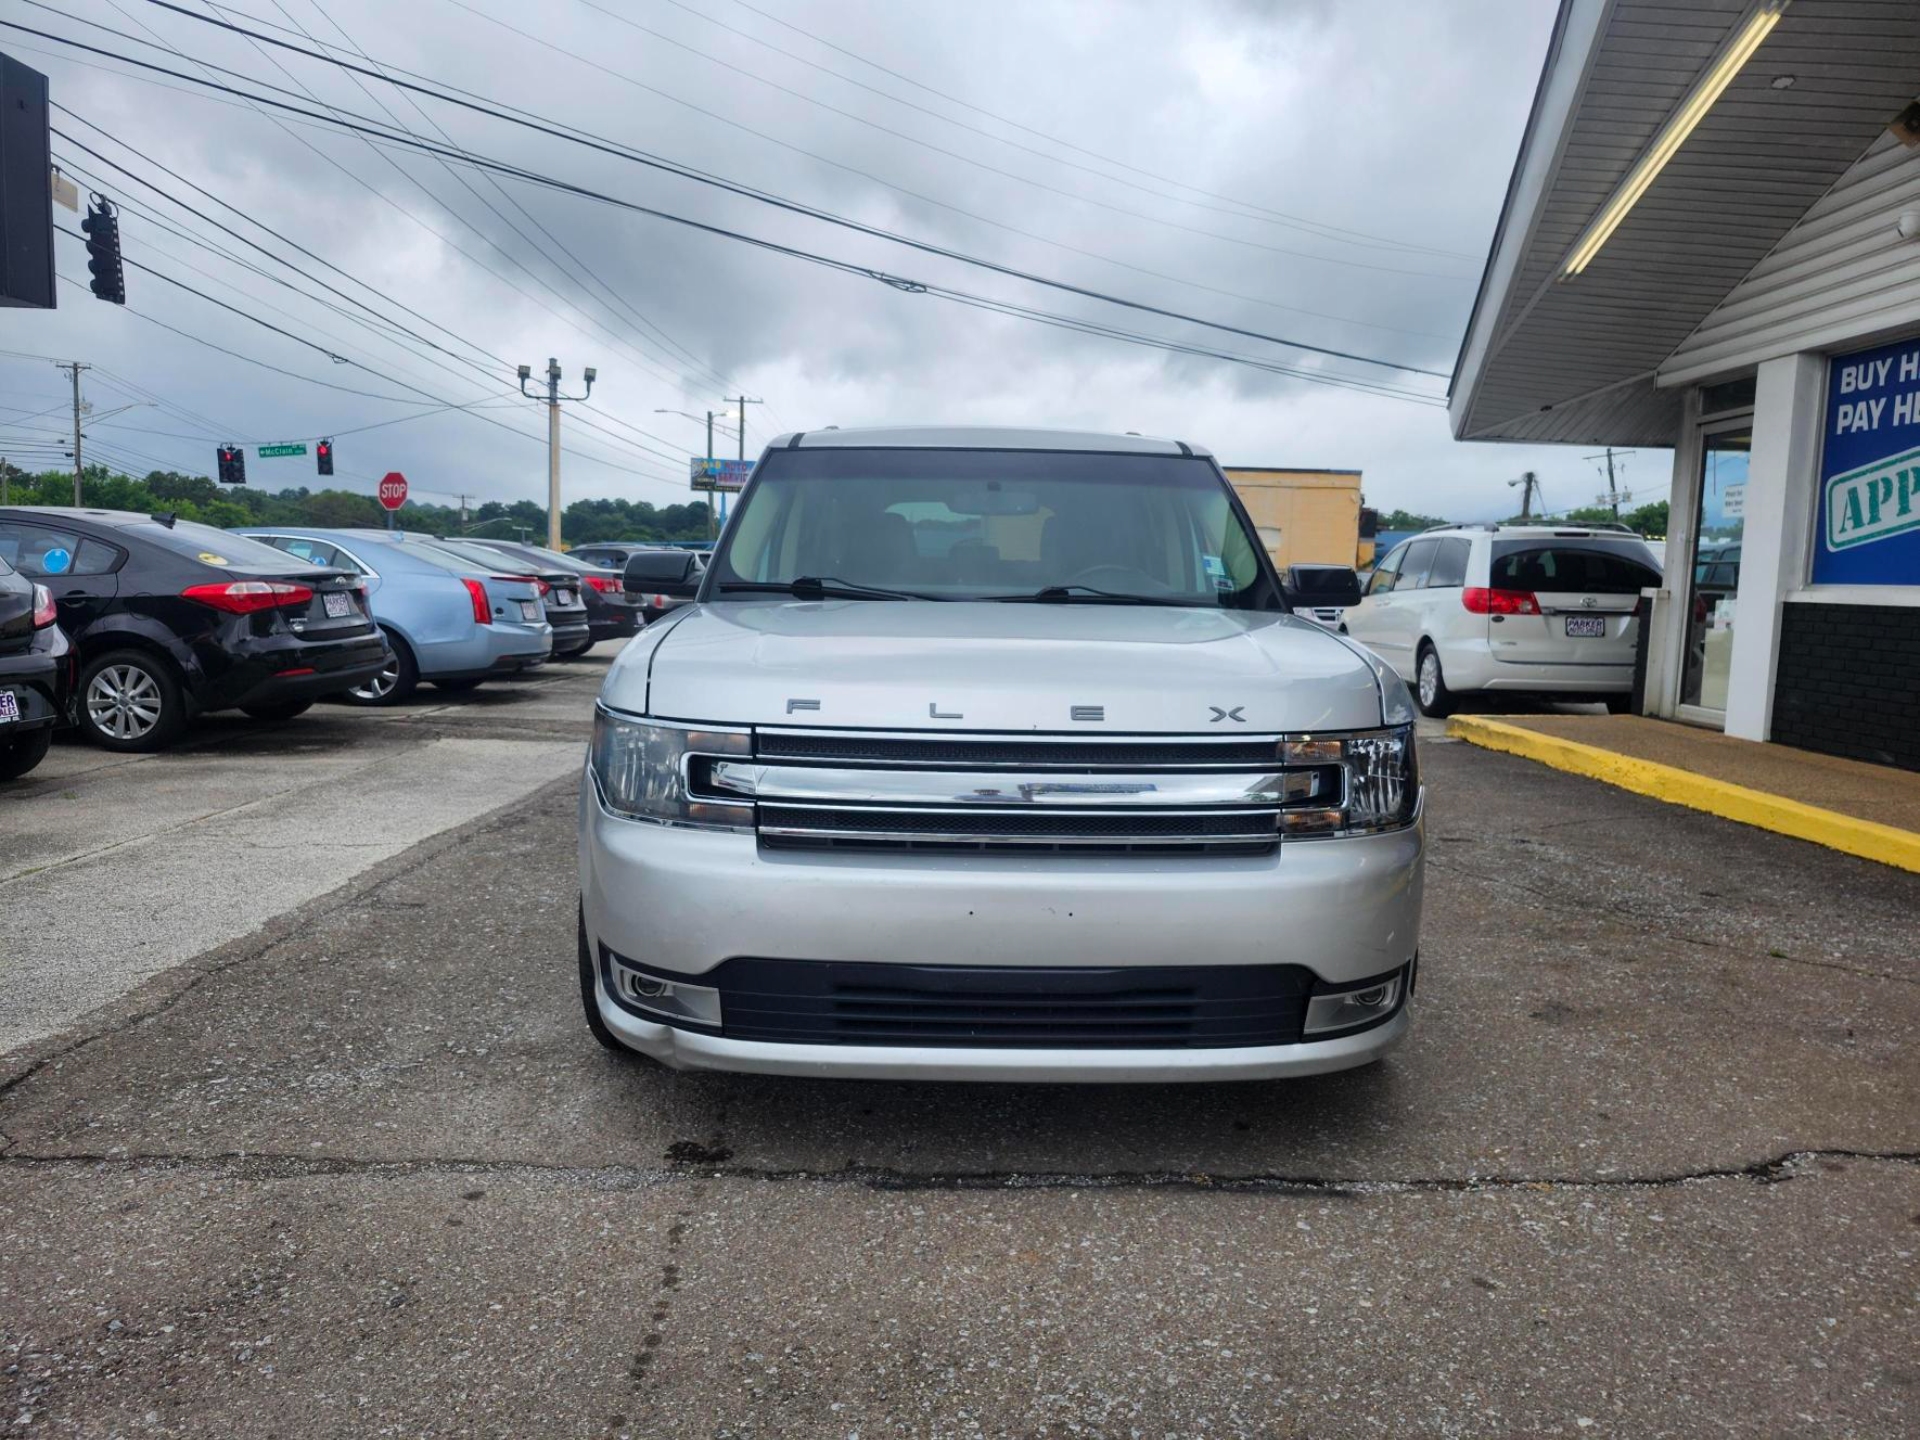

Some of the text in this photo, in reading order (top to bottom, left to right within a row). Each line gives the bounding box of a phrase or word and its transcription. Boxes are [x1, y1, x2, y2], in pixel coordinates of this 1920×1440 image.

[1840, 351, 1920, 394] BUY H
[1836, 397, 1887, 435] PAY
[381, 483, 407, 499] STOP
[1568, 619, 1603, 628] PARKER
[786, 698, 1247, 722] FLEX
